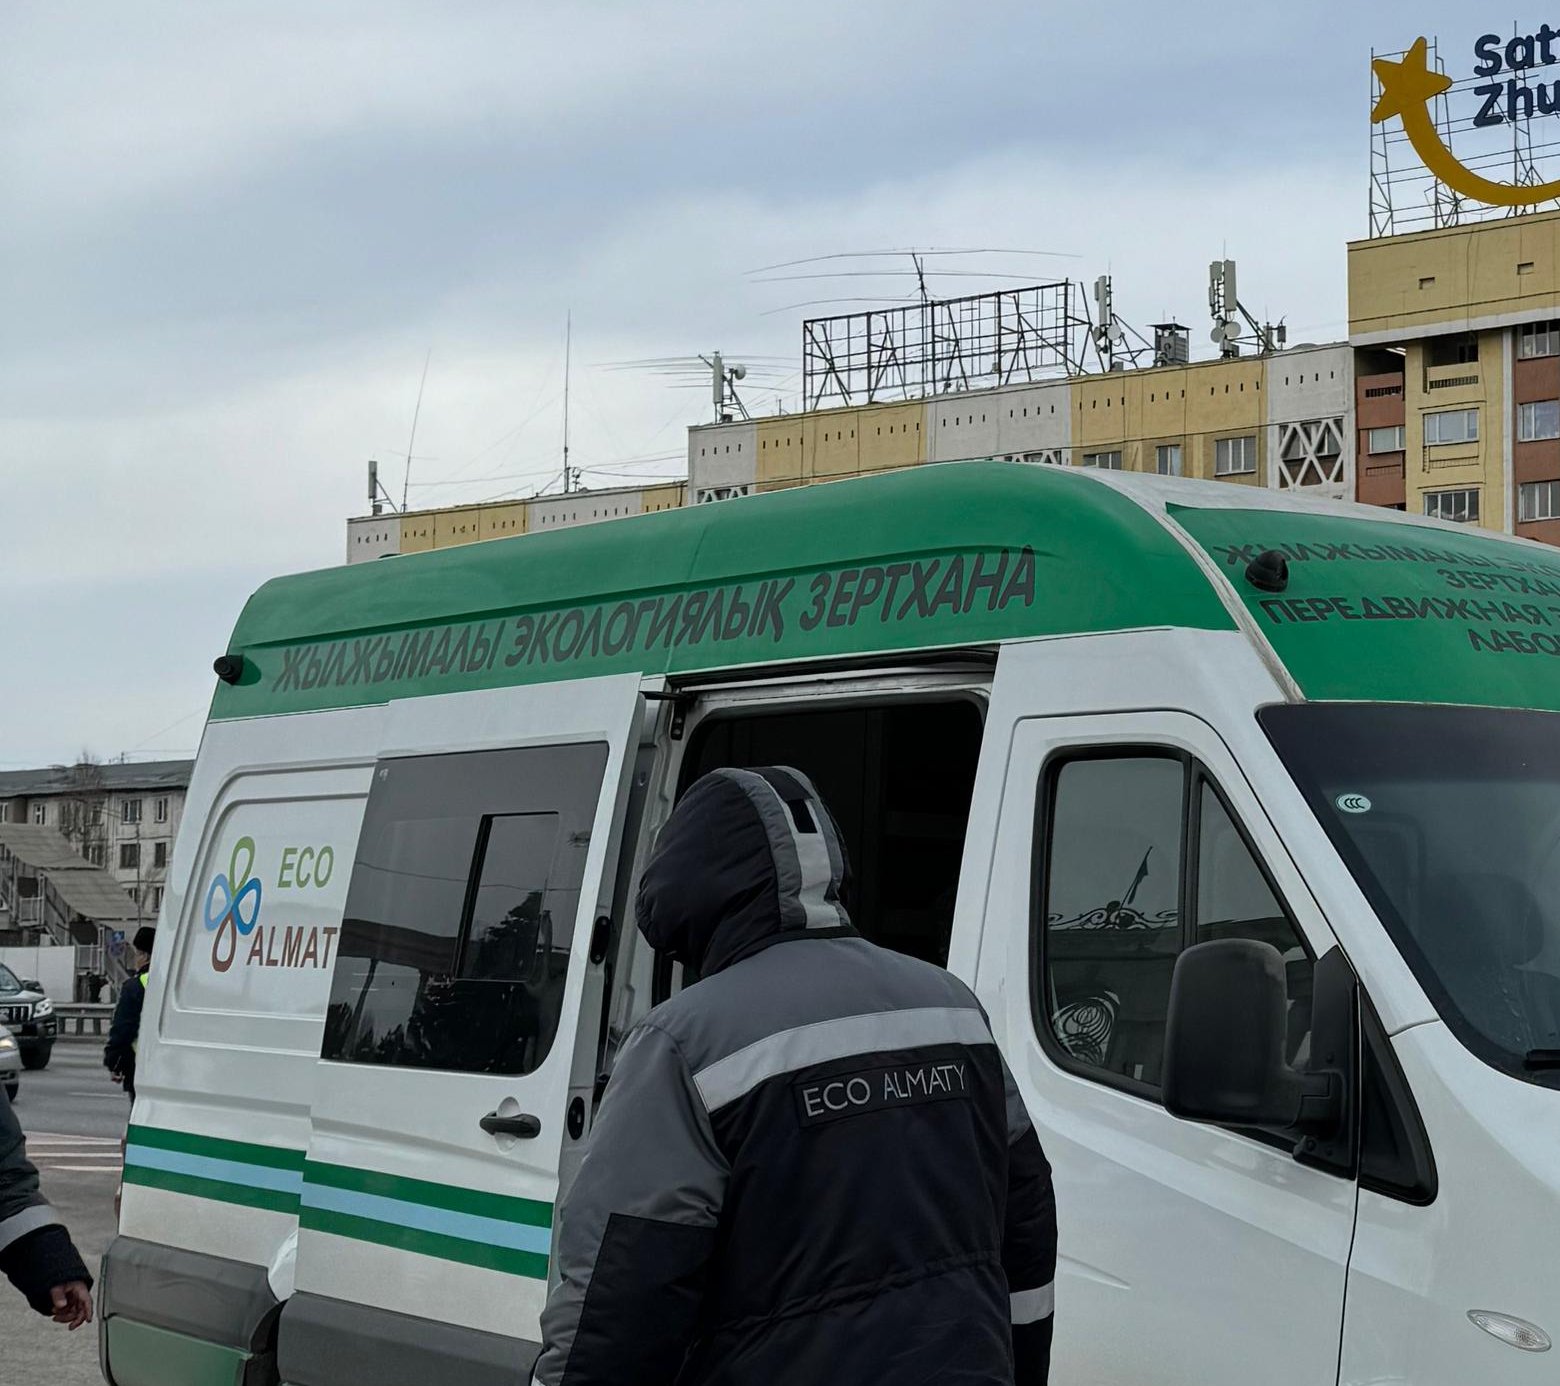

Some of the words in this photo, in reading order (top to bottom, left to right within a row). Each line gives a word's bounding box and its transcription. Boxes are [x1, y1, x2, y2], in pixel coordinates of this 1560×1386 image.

[271, 619, 506, 694] ЖЫЛЖЫМАЛЫ
[504, 577, 796, 668] ЭКОЛОГИЯЛЫҚ
[799, 544, 1036, 632] ЗЕРТХАНА
[1259, 596, 1552, 627] ПЕРЕДВИЖНАЯ
[277, 845, 334, 888] ECO
[246, 925, 340, 969] ALMAT
[802, 1077, 871, 1117] ECO
[883, 1064, 965, 1100] ALMATY
